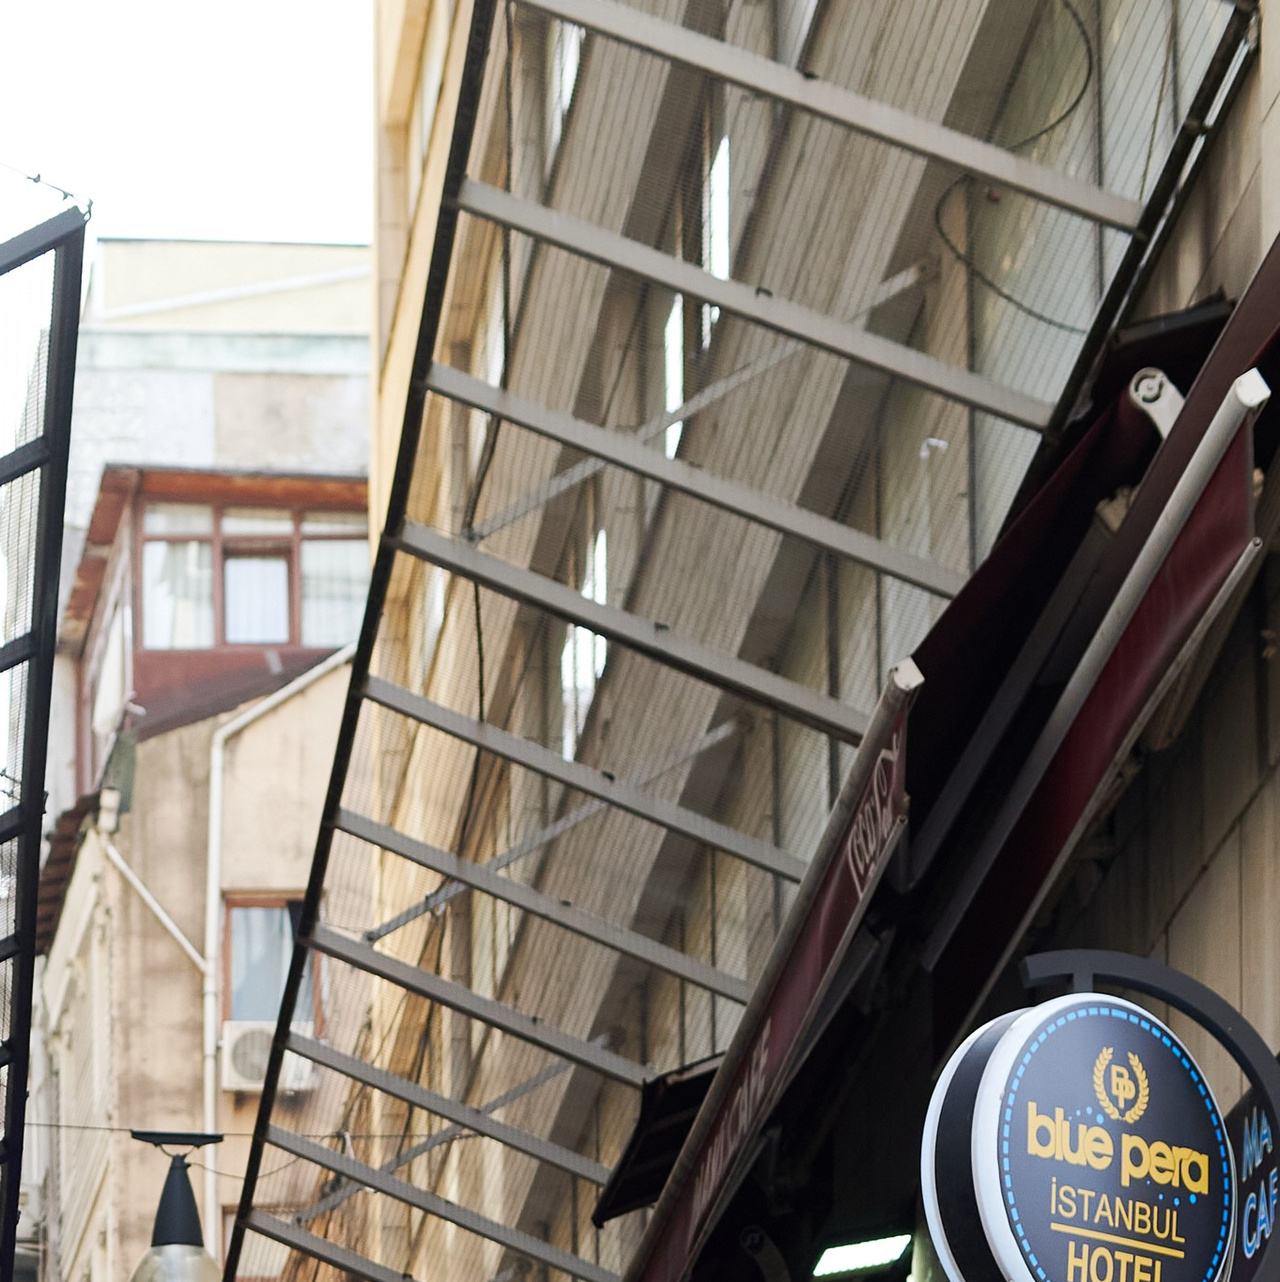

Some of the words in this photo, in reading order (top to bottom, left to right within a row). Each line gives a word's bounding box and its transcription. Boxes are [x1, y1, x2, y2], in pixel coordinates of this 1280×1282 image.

[1027, 1100, 1114, 1171] blue
[1122, 1133, 1210, 1195] pera
[1242, 1105, 1273, 1183] MA
[1050, 1176, 1186, 1244] İSTANBUL
[1242, 1166, 1279, 1260] CAF
